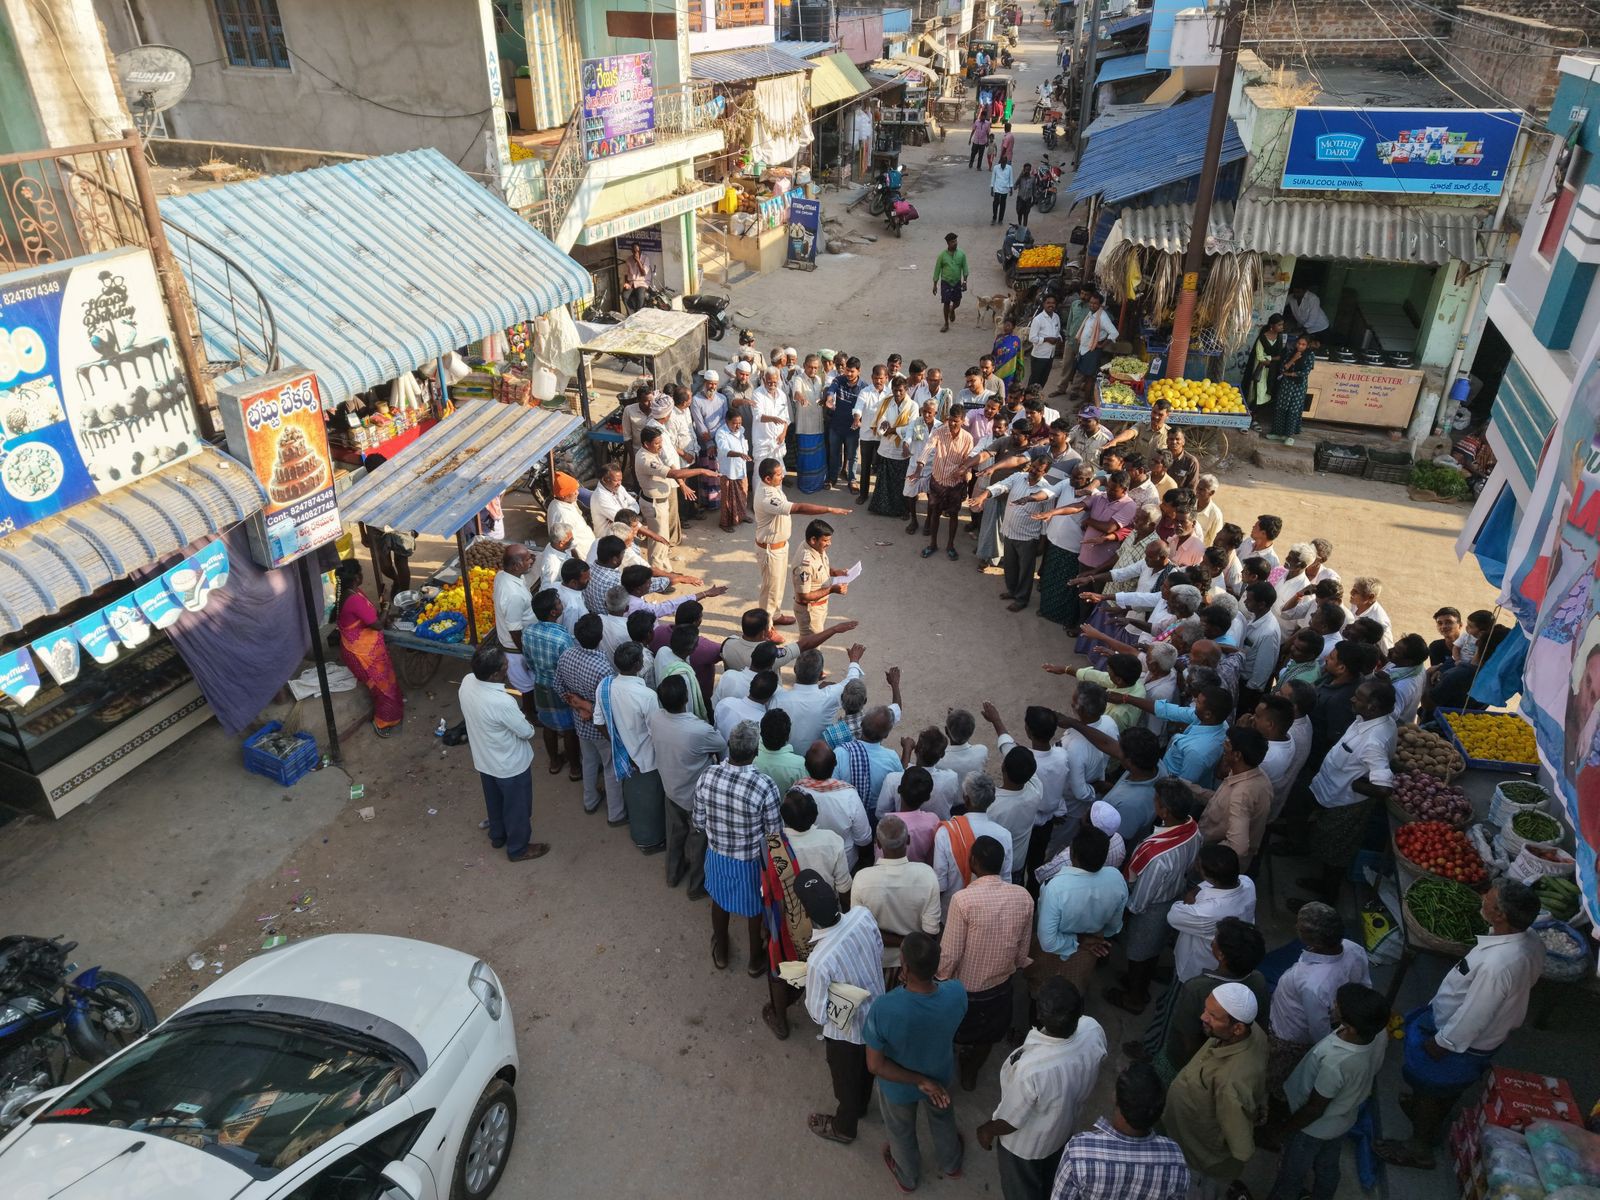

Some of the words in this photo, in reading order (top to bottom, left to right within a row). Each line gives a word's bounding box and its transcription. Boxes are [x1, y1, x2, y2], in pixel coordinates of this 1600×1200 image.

[1320, 140, 1359, 150] MOTHER
[1292, 178, 1315, 186] SURAJ
[1316, 179, 1336, 187] COOL
[1337, 180, 1363, 188] DRINKS
[3, 281, 60, 305] 8247874349
[81, 294, 128, 317] Happy
[83, 304, 136, 337] Birthday
[1348, 373, 1370, 383] JUICE
[1371, 375, 1404, 385] CENTER
[281, 381, 318, 415] బేకర్స్
[290, 490, 334, 515] 8247874349
[292, 501, 335, 526] 9440827748
